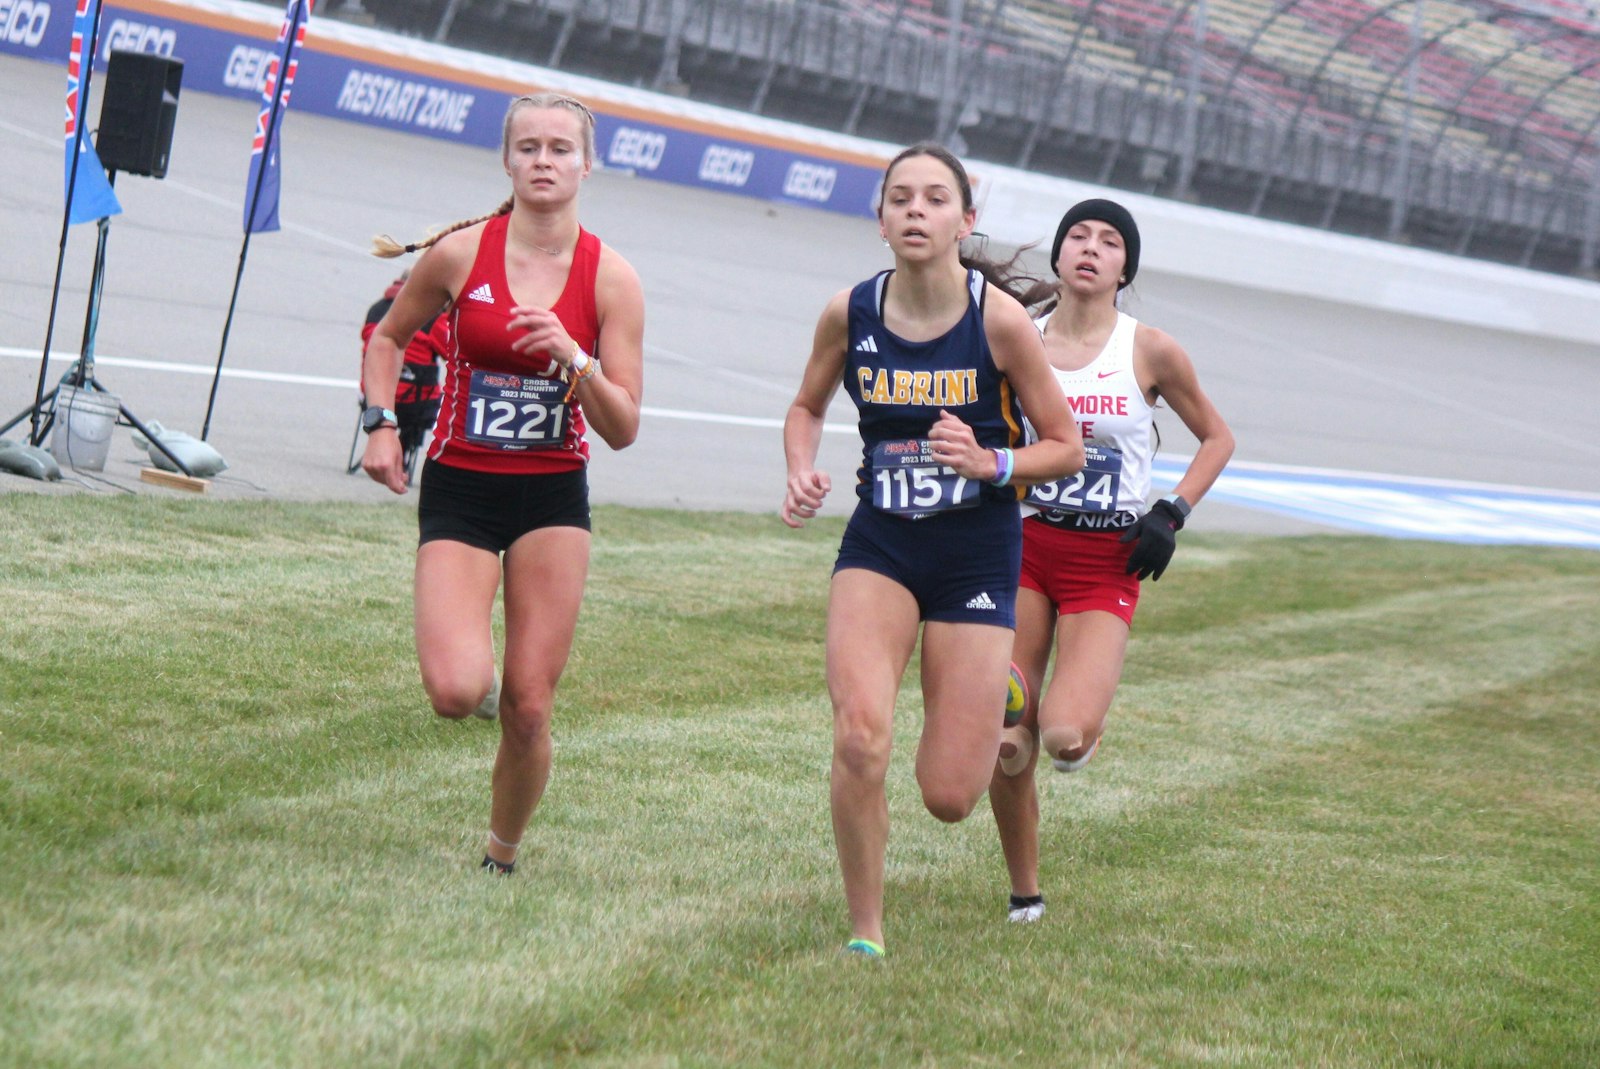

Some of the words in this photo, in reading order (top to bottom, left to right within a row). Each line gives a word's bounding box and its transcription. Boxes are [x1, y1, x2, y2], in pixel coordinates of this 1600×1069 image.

[0, 0, 51, 48] EICO
[336, 69, 424, 124] RESTART
[415, 87, 475, 134] ZONE
[608, 126, 667, 170] GEICO
[698, 144, 754, 187] GEICO
[783, 160, 837, 202] GEICO
[468, 293, 495, 304] adidas
[500, 390, 519, 398] 2023
[520, 392, 541, 400] FINAL
[522, 385, 559, 393] COUNTRY
[857, 366, 979, 406] CABRINI
[471, 397, 564, 439] 1221
[901, 456, 919, 464] 2023
[877, 467, 968, 509] 1157
[966, 602, 997, 610] adidas
